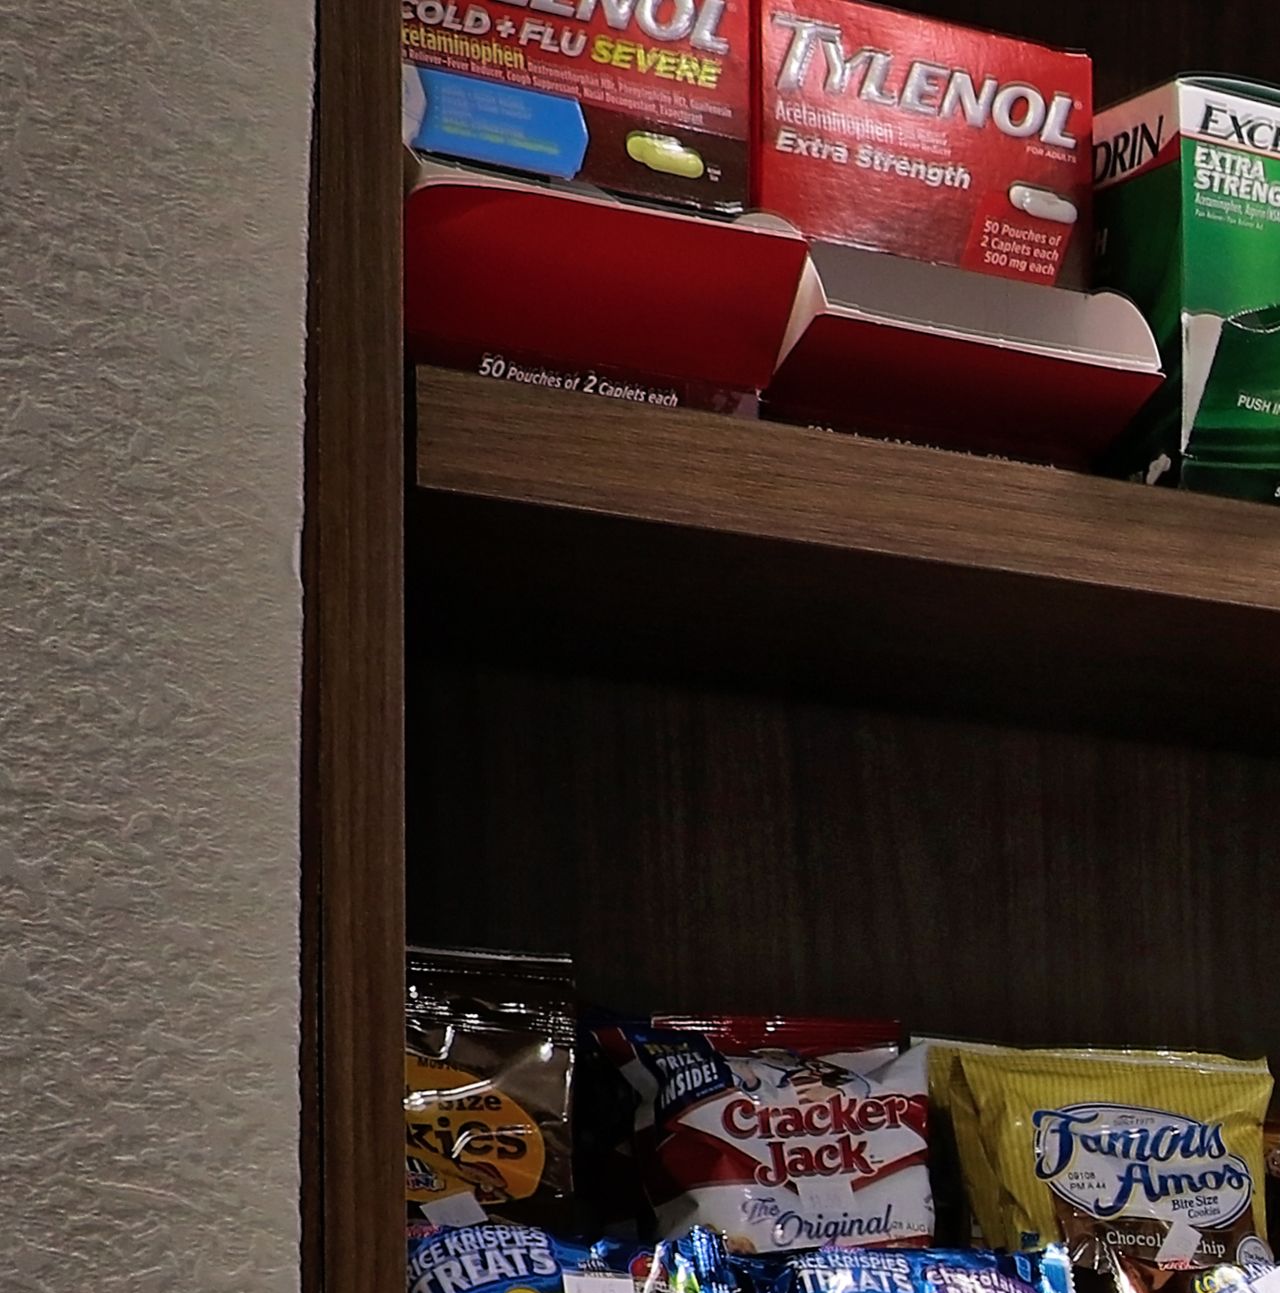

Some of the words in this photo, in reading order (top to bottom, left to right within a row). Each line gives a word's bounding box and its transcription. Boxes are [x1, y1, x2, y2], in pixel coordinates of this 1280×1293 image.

[519, 18, 588, 57] FLU
[591, 35, 723, 90] SEVERE
[772, 11, 1077, 150] TYLENOL
[775, 102, 894, 144] Acetaminophen
[775, 130, 848, 163] Extra
[855, 143, 971, 190] Strength
[1195, 146, 1265, 182] EXTRA
[984, 220, 998, 235] 50
[1001, 225, 1047, 245] Pouches
[1049, 234, 1062, 247] of
[991, 239, 1031, 259] Caplets
[1033, 247, 1059, 261] each
[984, 251, 1007, 267] 500
[1009, 258, 1027, 273] mg
[1028, 261, 1055, 276] each
[479, 358, 505, 379] 50
[507, 366, 563, 391] Pouches
[565, 375, 580, 390] of
[583, 374, 597, 394] 2
[599, 382, 646, 402] Caplets
[647, 391, 678, 408] each
[1237, 394, 1271, 412] PUSH
[721, 1095, 909, 1139] Cracker
[755, 1138, 875, 1187] Jack
[1031, 1109, 1227, 1180] Famous
[1094, 1162, 1251, 1217] Amos
[741, 1197, 780, 1225] The
[771, 1204, 893, 1247] Original
[449, 1226, 549, 1258] KRISPIES
[829, 1253, 911, 1272] KRISPIES
